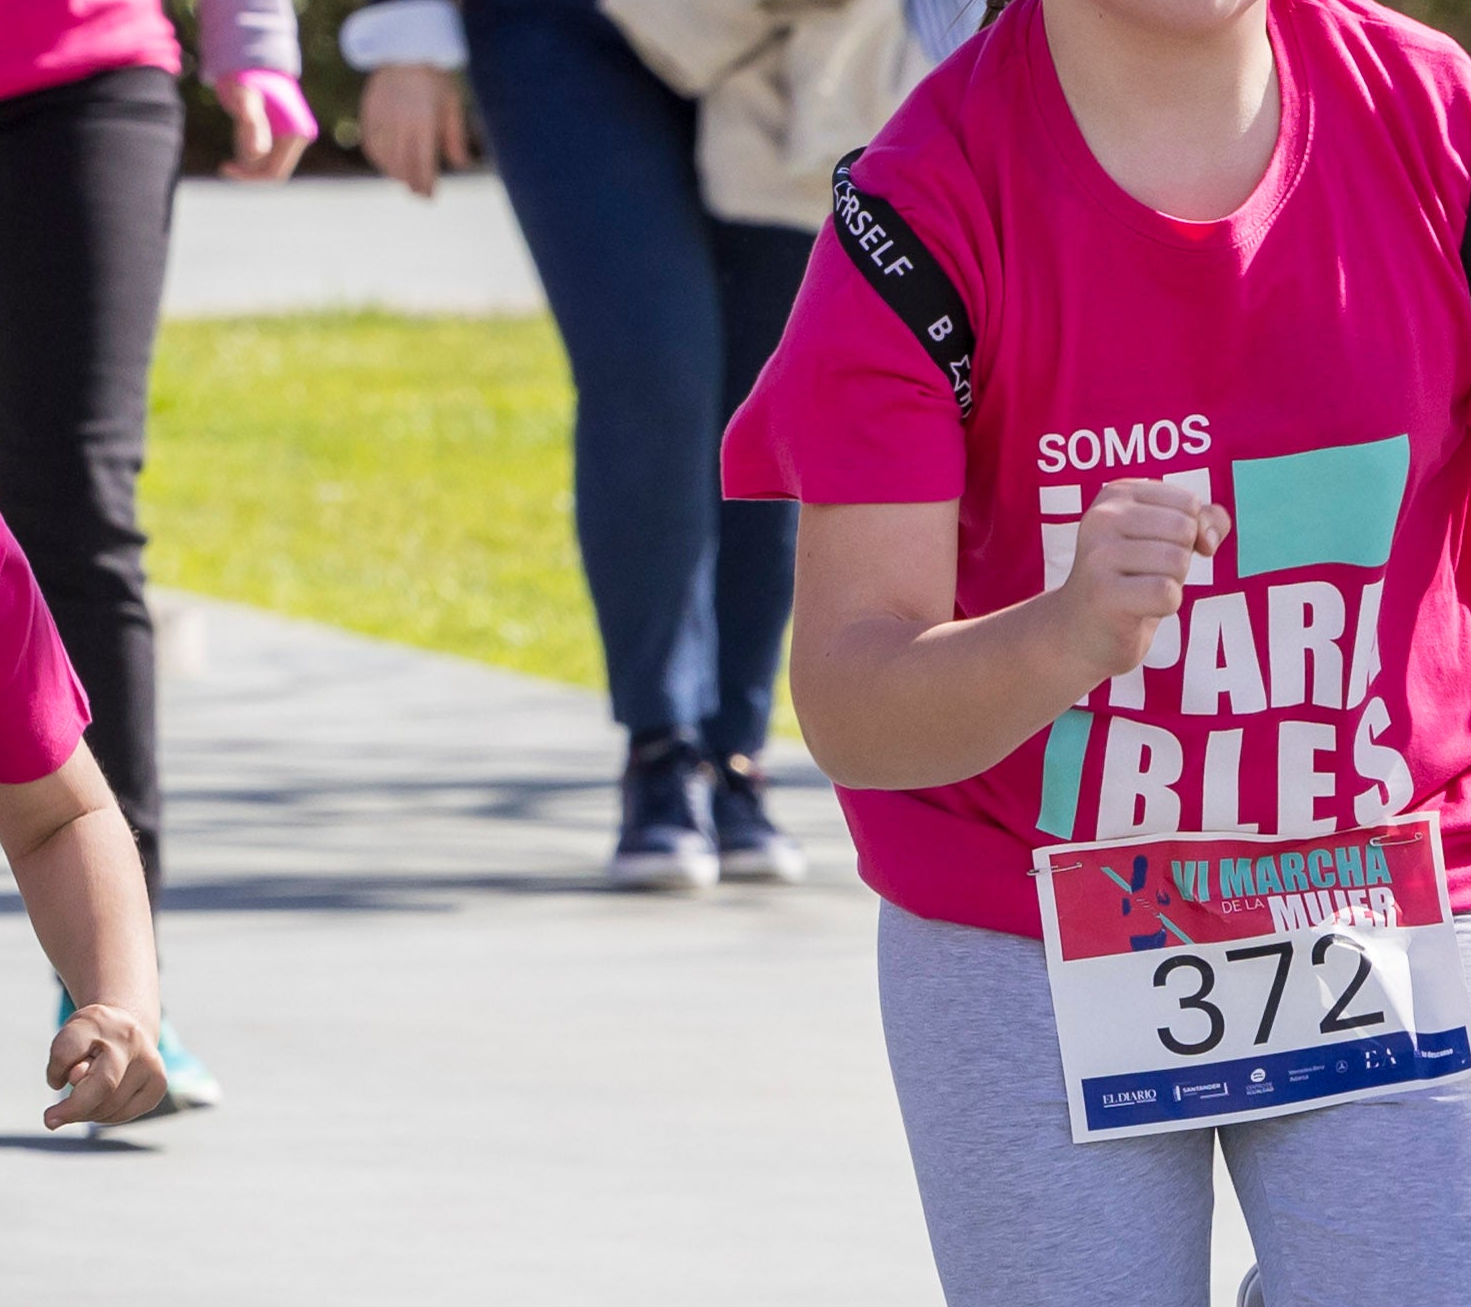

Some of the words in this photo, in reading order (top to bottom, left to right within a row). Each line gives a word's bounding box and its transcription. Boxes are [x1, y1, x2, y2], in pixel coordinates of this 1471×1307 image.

[1036, 414, 1213, 473] SOMOS
[1096, 696, 1415, 840] BLES
[1171, 860, 1211, 903] VI
[1219, 844, 1393, 899] MARCHA
[1221, 899, 1243, 915] DE
[1244, 896, 1266, 911] LA
[1266, 886, 1399, 936] MUJER
[1152, 934, 1386, 1057] 372
[1118, 1088, 1157, 1103] DIARIO
[1182, 1083, 1221, 1093] SANTANDER
